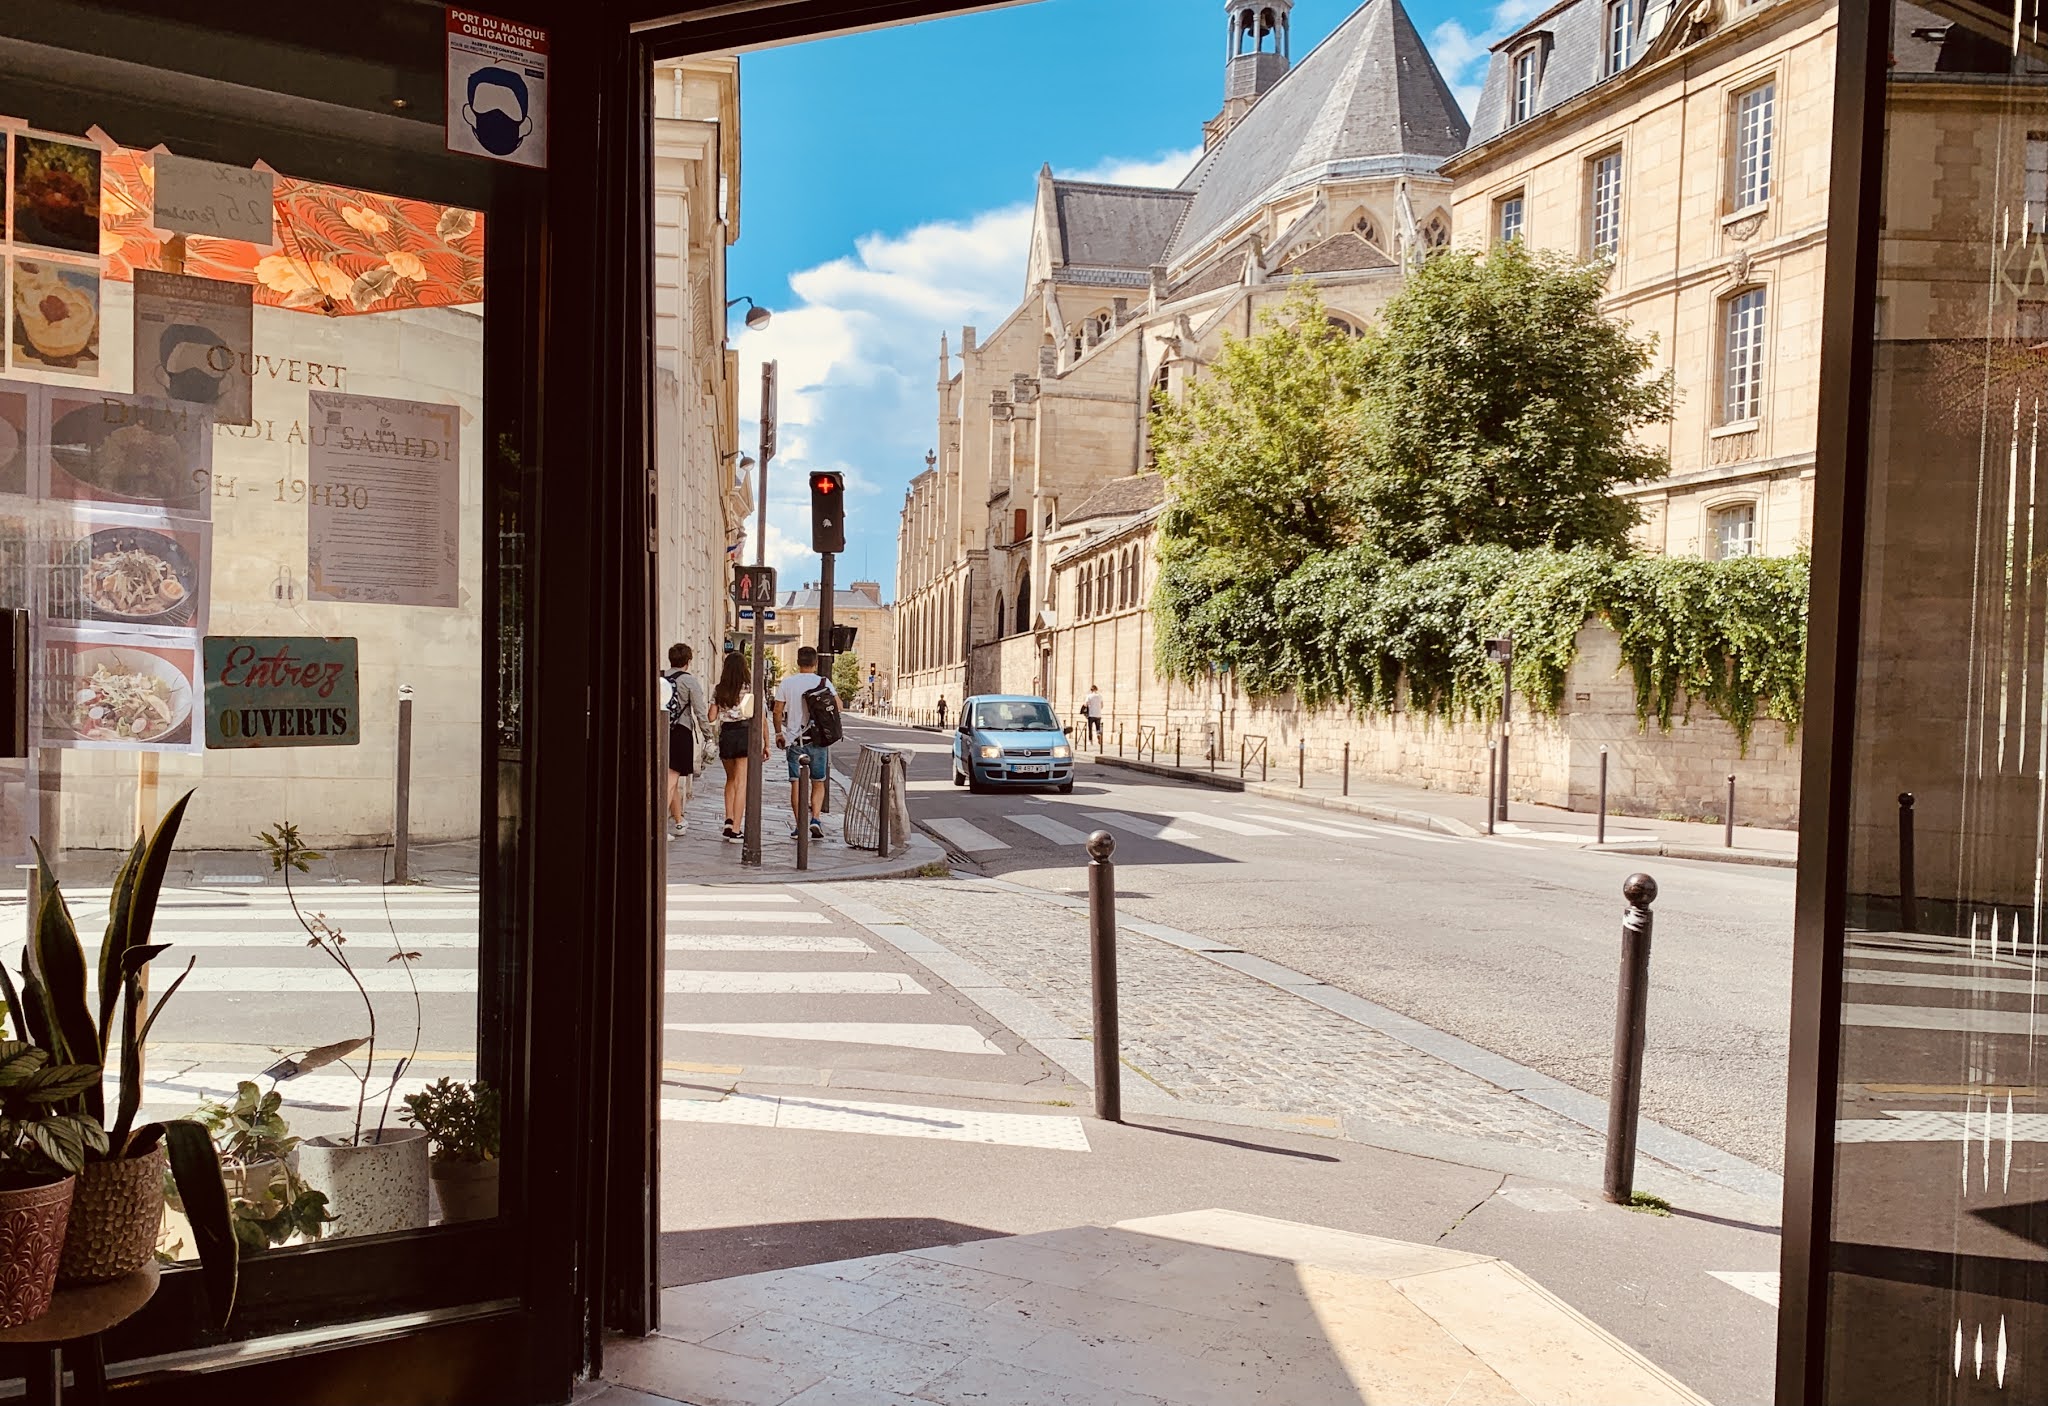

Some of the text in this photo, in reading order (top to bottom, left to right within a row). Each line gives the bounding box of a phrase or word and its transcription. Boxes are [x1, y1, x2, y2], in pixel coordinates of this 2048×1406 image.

[452, 10, 546, 41] PORT DU MASQUE
[462, 23, 535, 49] OBLIGATOIRE.
[206, 345, 347, 388] OUVERT
[286, 419, 329, 447] AU
[341, 426, 452, 462] SAMEDI
[192, 469, 239, 498] 9H
[273, 476, 369, 510] 19H30
[220, 645, 345, 698] Entrez
[219, 708, 347, 738] OUVERTS
